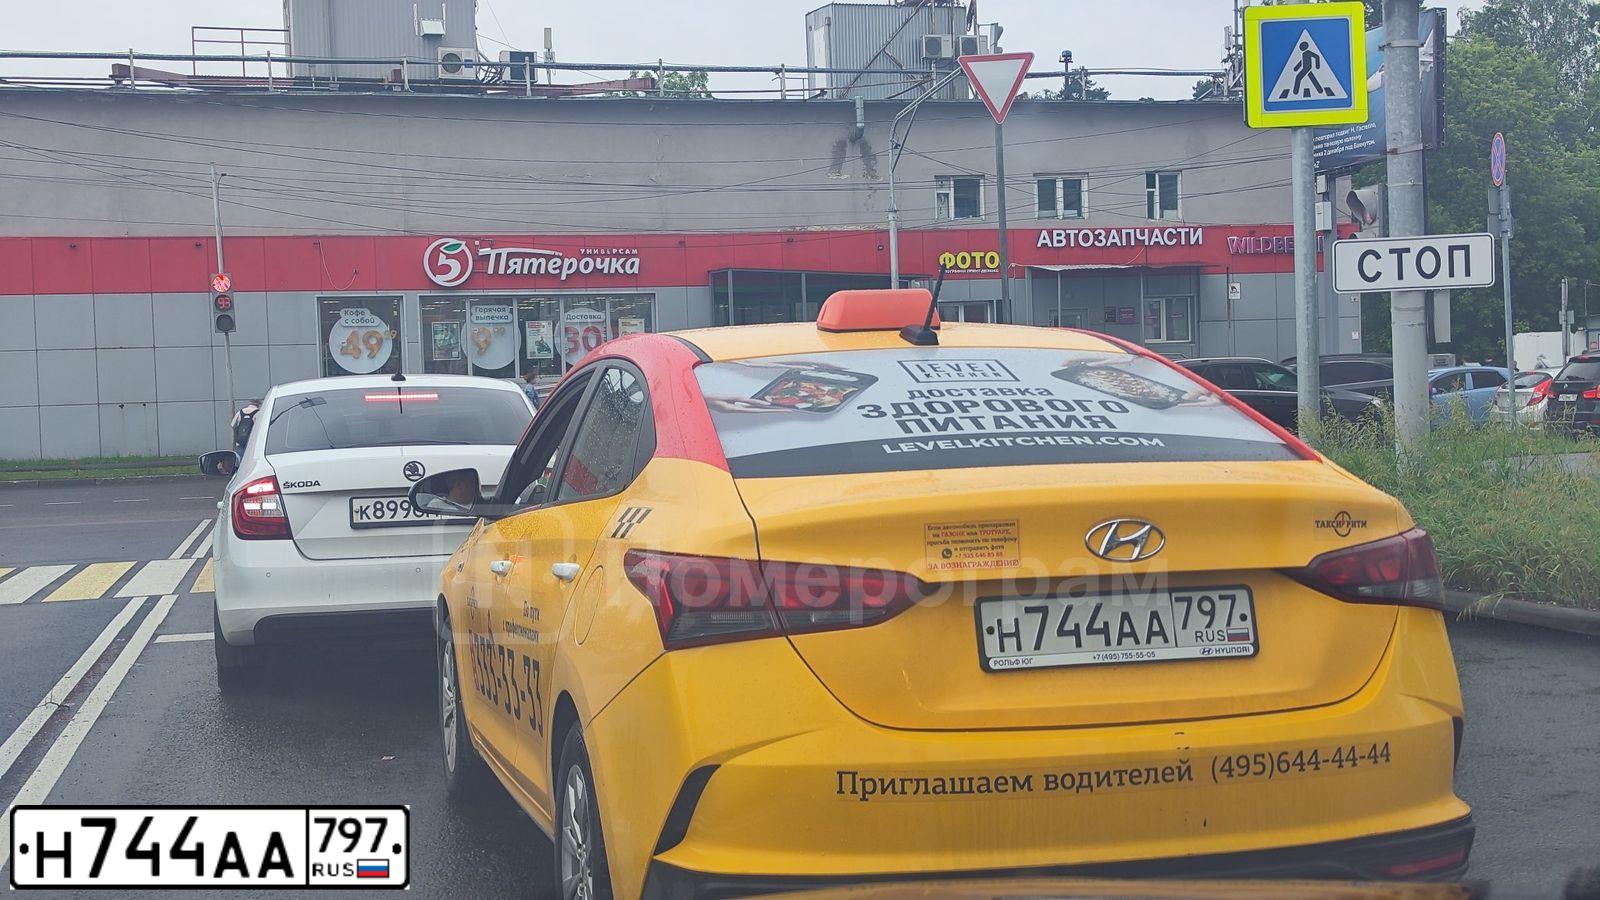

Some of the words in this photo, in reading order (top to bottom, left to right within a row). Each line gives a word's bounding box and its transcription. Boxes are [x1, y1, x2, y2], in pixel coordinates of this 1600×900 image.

[1037, 228, 1203, 248] АВТОЗАПЧАСТИ
[479, 248, 640, 280] Пятерочка
[939, 252, 1000, 269] ФОТО
[1357, 244, 1471, 283] СТОП
[344, 309, 366, 317] Кофе
[340, 330, 383, 360] 49
[908, 387, 1054, 400] доставка
[856, 399, 1130, 420] ЗДОРОВОГО
[895, 415, 1118, 434] ПИТАНИЯ
[881, 436, 1166, 454] LEVELKITCHEN.COM
[283, 480, 320, 489] ŠKODA
[940, 560, 1018, 569] ВОЗНАГРАЖДЕНИЕ!
[997, 603, 1169, 652] Н744АА
[1174, 594, 1237, 630] 797
[1195, 630, 1226, 643] RUS
[994, 658, 1020, 667] РОЛЬФ
[1022, 658, 1033, 666] ЮГ
[1102, 653, 1120, 662] (495)
[1121, 652, 1156, 660] 755-55-05
[836, 770, 1034, 801] Приглашаем
[1044, 760, 1194, 792] водителей
[1211, 741, 1392, 785] (495)644-44-44
